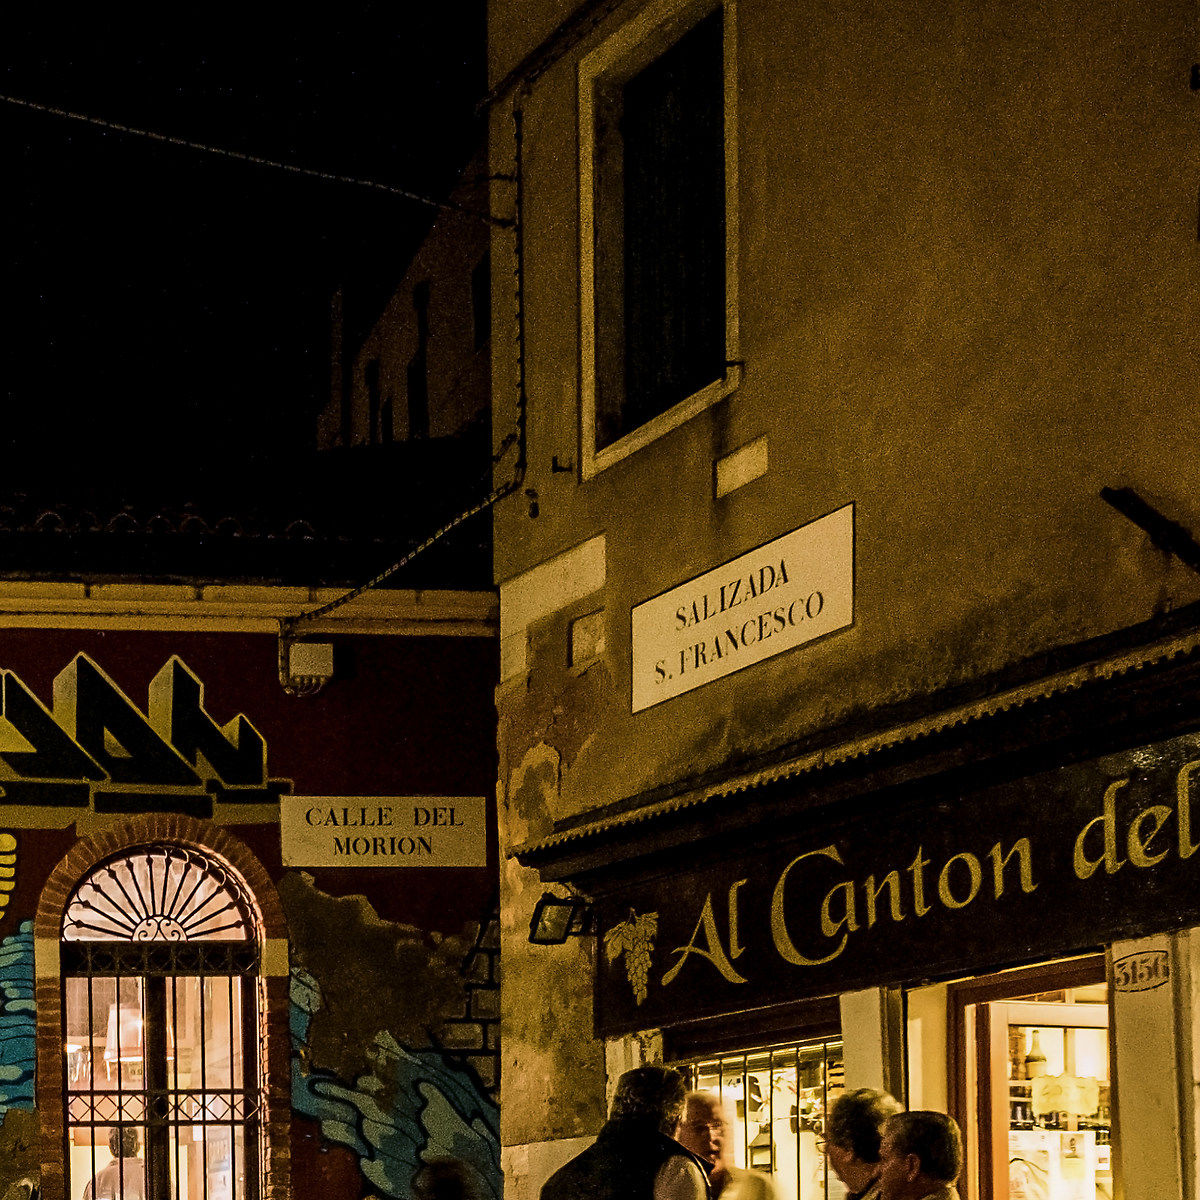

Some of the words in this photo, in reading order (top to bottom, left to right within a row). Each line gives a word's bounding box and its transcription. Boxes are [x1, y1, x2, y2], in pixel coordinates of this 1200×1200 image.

[676, 559, 789, 632] SALIZADA
[655, 659, 673, 685] S.
[679, 591, 825, 675] FRANCESCO
[305, 807, 394, 827] CALLE
[413, 807, 465, 827] DEL
[333, 836, 433, 856] MORION
[661, 878, 748, 986] Al
[770, 836, 1040, 967] Canton
